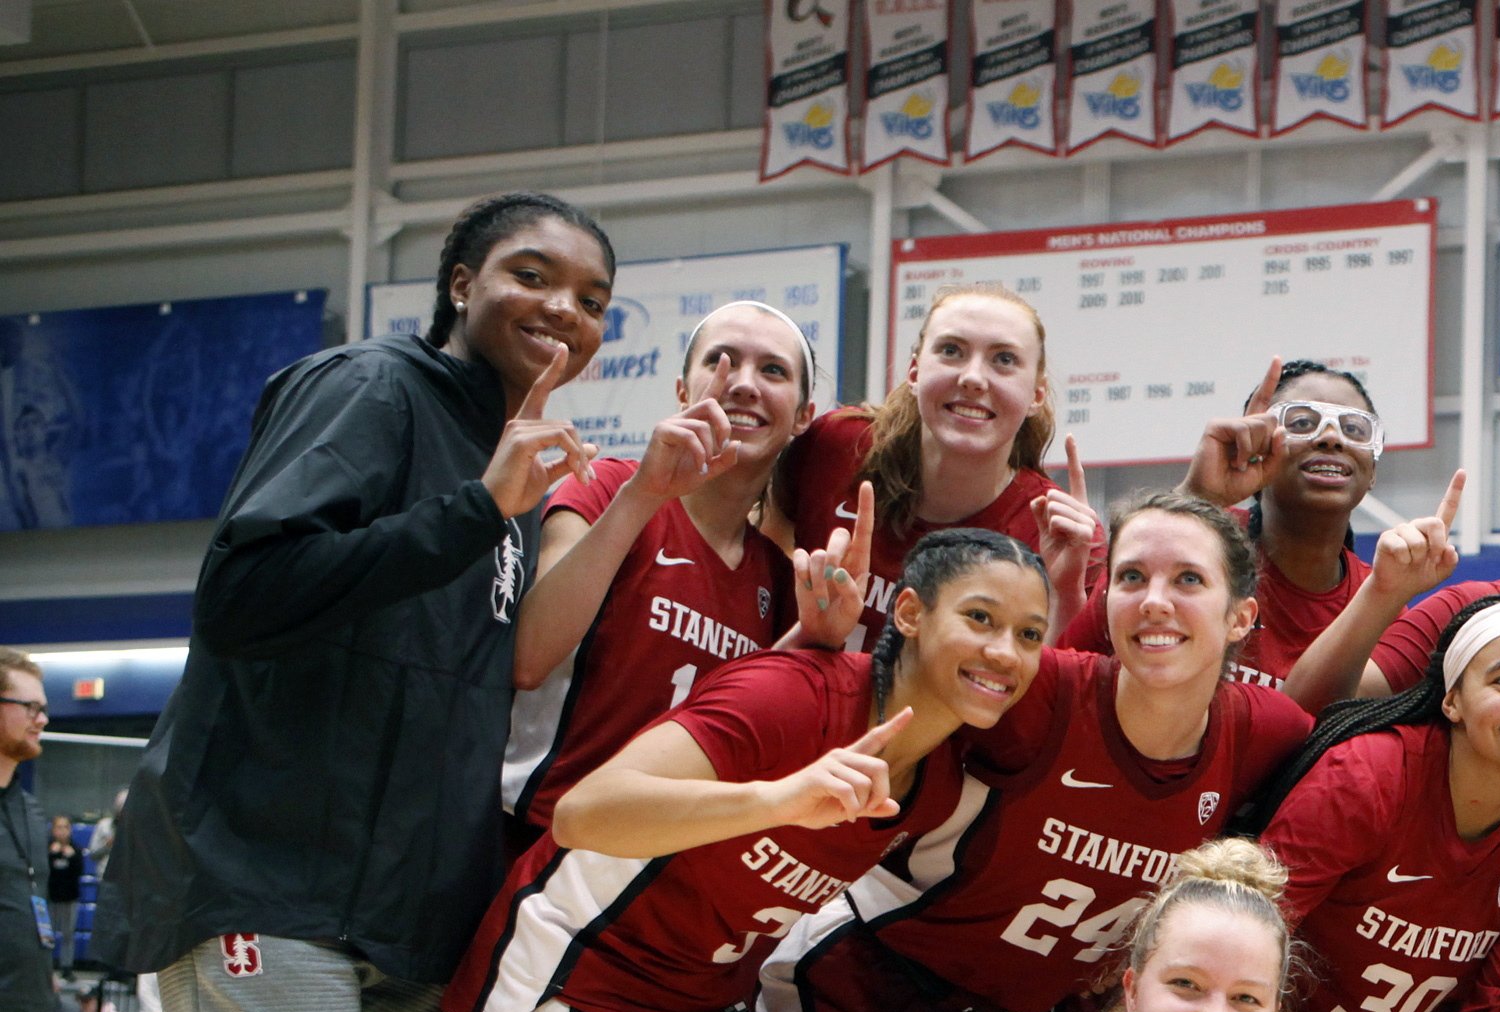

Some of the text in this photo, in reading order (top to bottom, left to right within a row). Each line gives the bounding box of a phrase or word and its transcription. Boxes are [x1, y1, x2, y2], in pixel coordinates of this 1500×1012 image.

[1046, 220, 1267, 250] MEN'S NATIONAL CHAMPIONS
[649, 595, 763, 660] STANFO
[1037, 816, 1181, 888] STANFOR
[1000, 878, 1150, 963] 24
[1356, 905, 1500, 961] STANFORD
